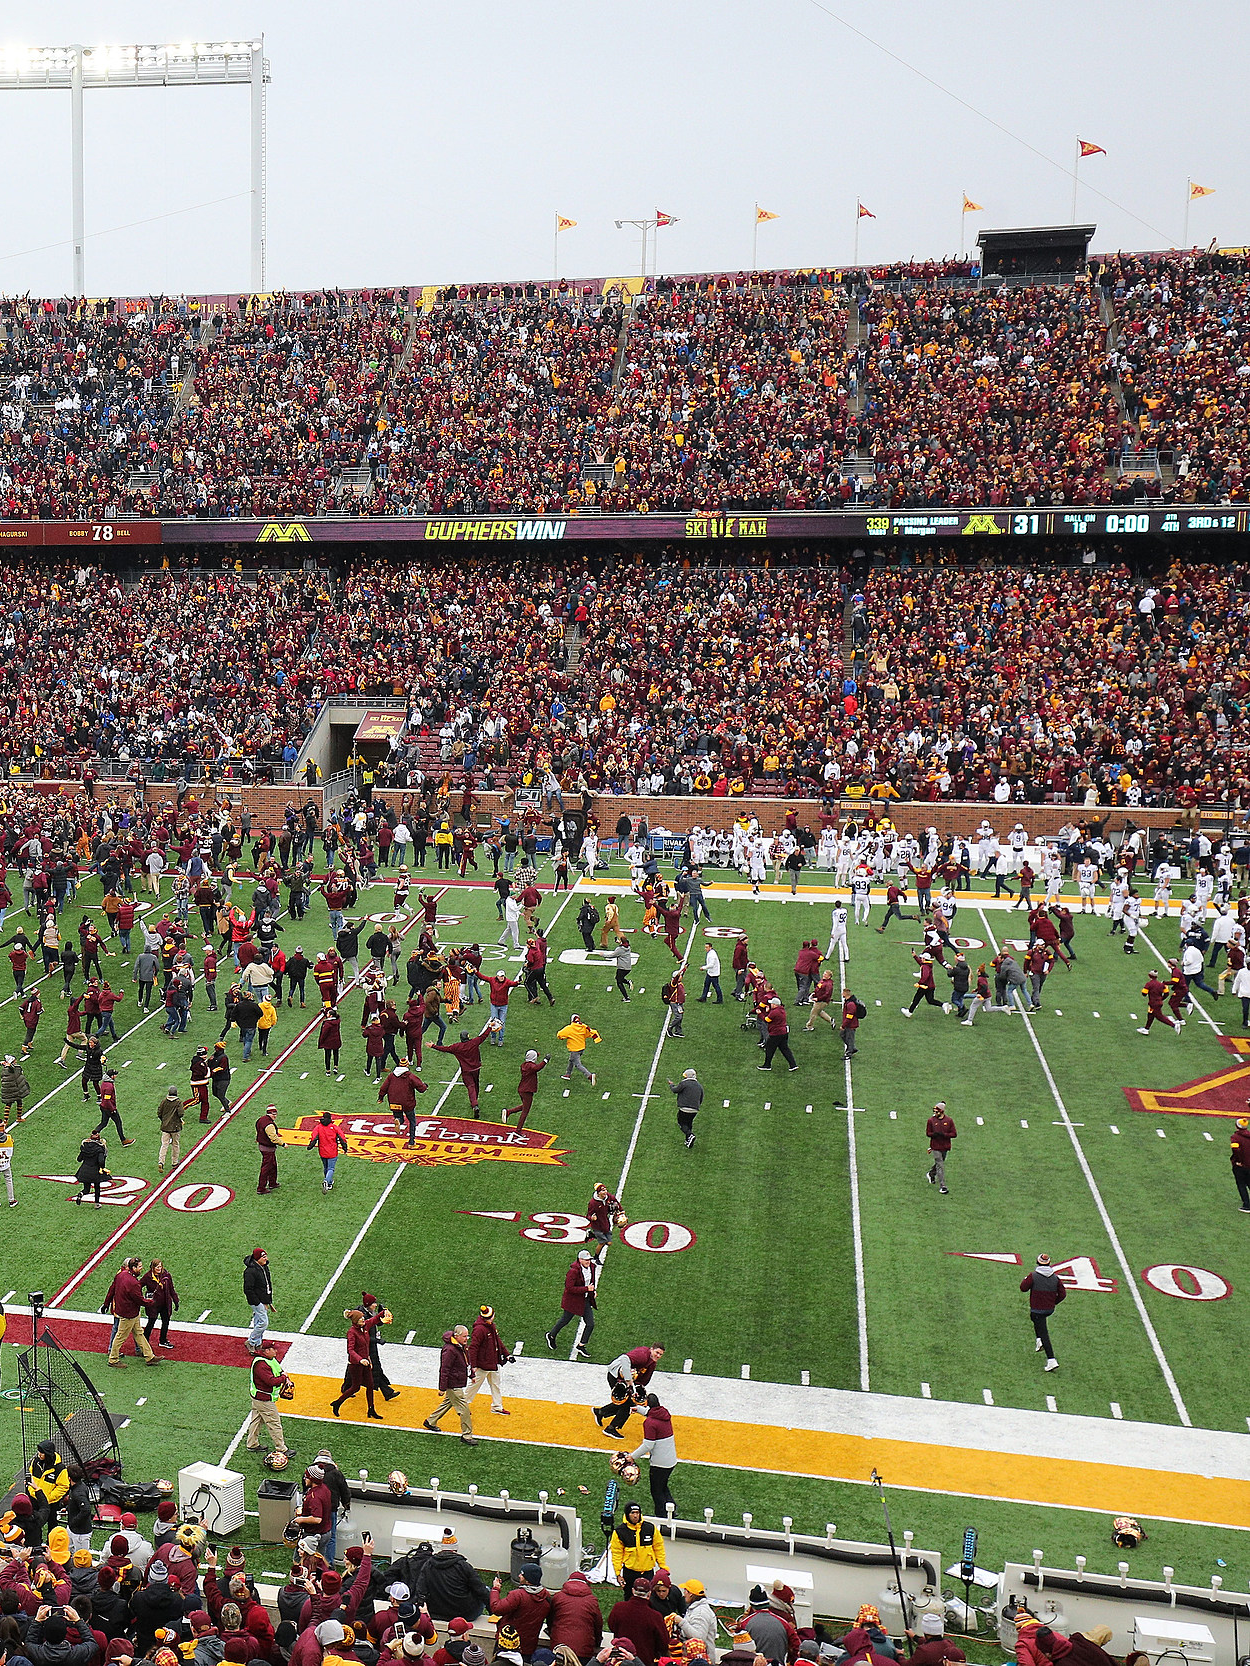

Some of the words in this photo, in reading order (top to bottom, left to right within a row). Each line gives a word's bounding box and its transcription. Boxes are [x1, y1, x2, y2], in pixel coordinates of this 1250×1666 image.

[930, 517, 959, 525] LEADER
[1064, 514, 1082, 522] BALL
[1105, 514, 1149, 533] 0:00
[1013, 514, 1039, 535] 31
[1072, 522, 1087, 534] 18
[1160, 522, 1180, 532] 4TH
[91, 525, 113, 541] 78
[868, 818, 874, 828] 8
[1081, 870, 1092, 878] 83
[855, 880, 867, 890] 93
[68, 1174, 235, 1214] 20
[518, 1211, 697, 1254] 30
[1047, 1256, 1234, 1302] 40
